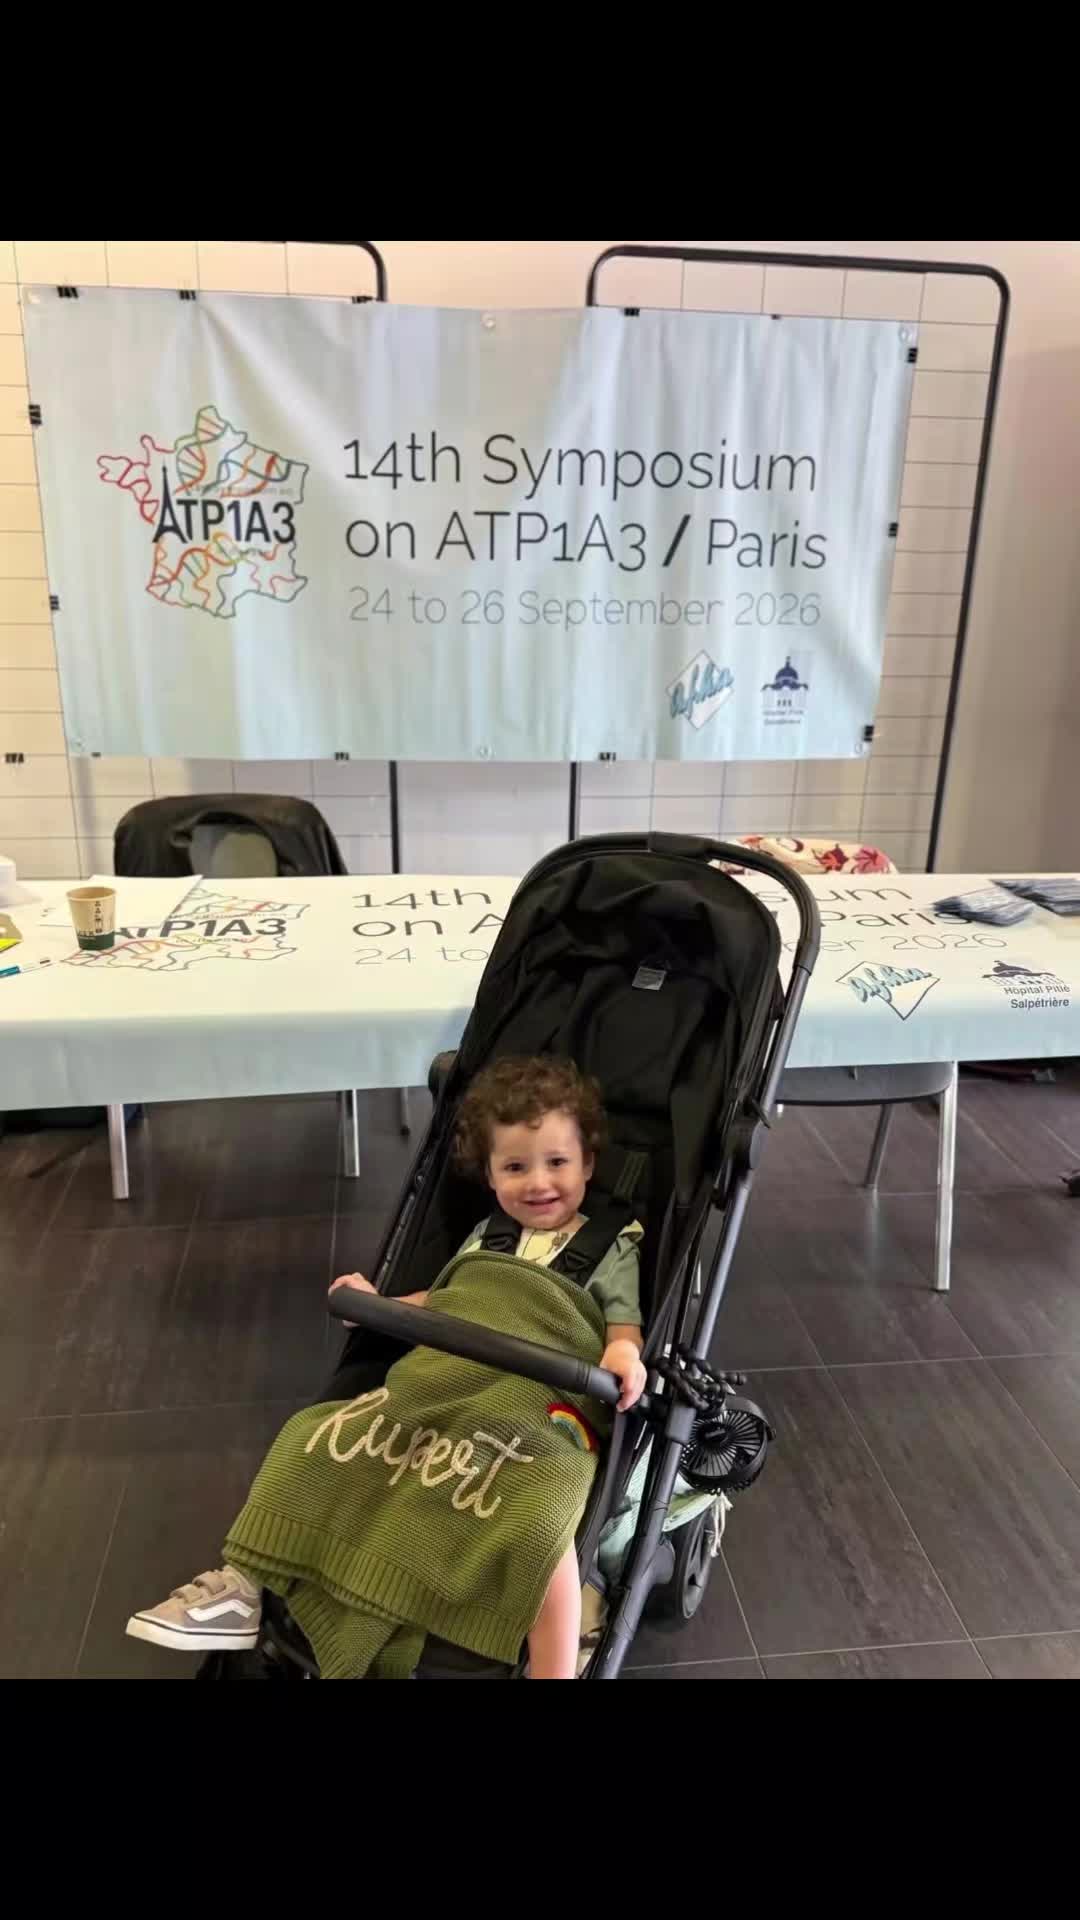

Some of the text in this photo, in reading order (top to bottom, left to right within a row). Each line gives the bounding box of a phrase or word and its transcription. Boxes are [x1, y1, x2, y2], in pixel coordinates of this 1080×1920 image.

[344, 430, 817, 501] 14th Symposium
[152, 463, 296, 544] ATP1A3
[345, 519, 416, 560] on
[436, 511, 647, 572] ATP1A3
[707, 518, 828, 570] Paris
[349, 586, 822, 632] 24 to 26 September 2026
[352, 888, 492, 909] 14th
[353, 920, 443, 936] on
[820, 908, 973, 928] Paris
[353, 946, 489, 964] 24 to
[881, 933, 1008, 951] 2026
[305, 1387, 534, 1519] Rupert
